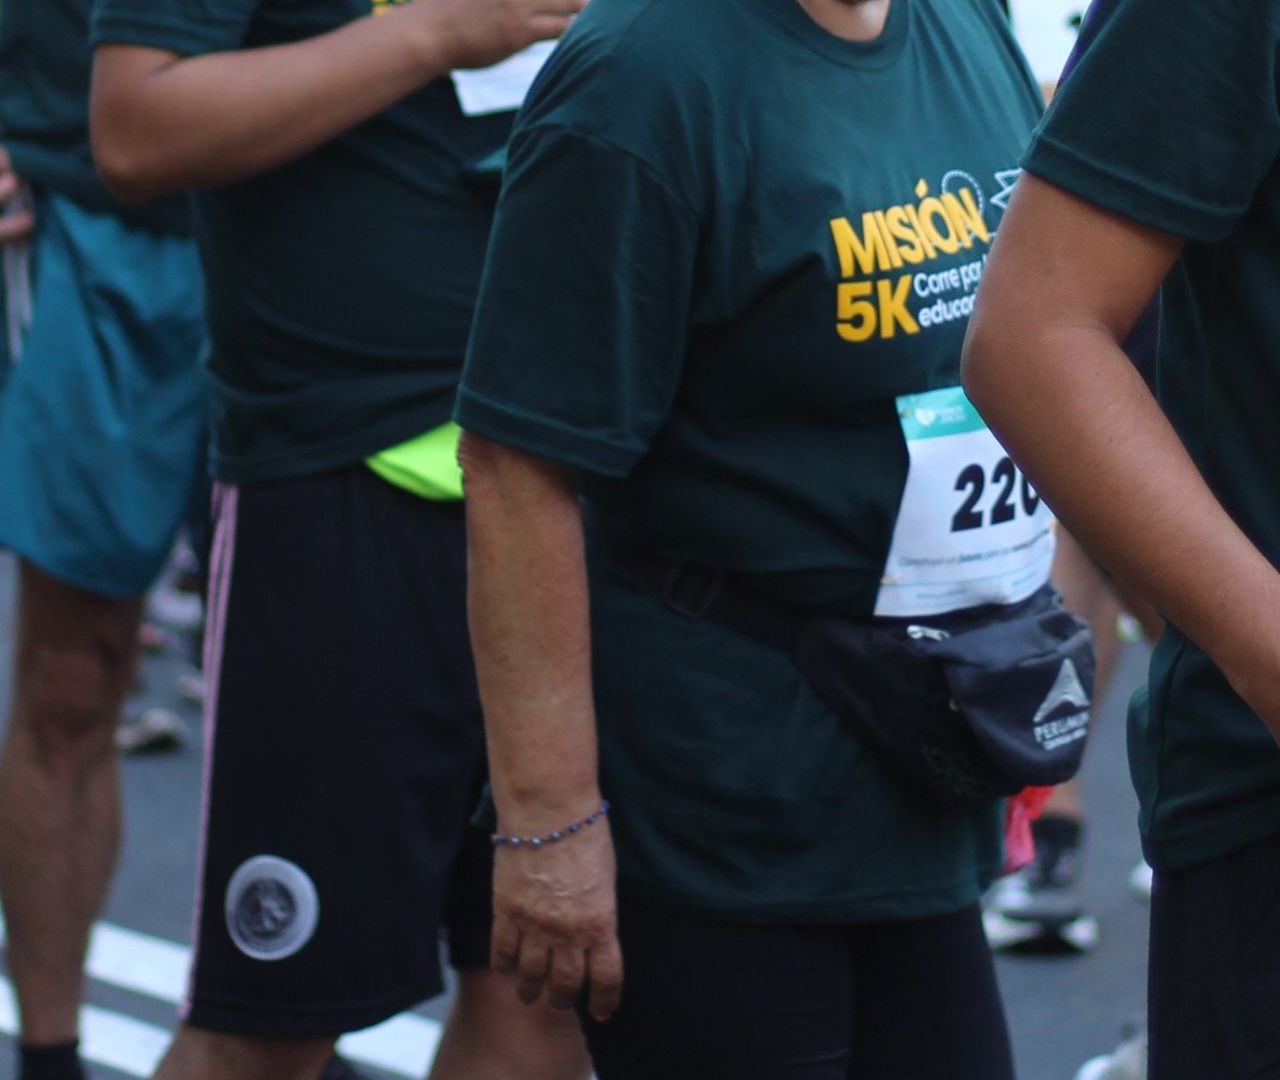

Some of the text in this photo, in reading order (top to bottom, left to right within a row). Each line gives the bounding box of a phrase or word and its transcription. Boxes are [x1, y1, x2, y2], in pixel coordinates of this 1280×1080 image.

[830, 178, 990, 278] MISIÓN
[836, 274, 920, 343] 5K
[914, 268, 960, 297] Corre
